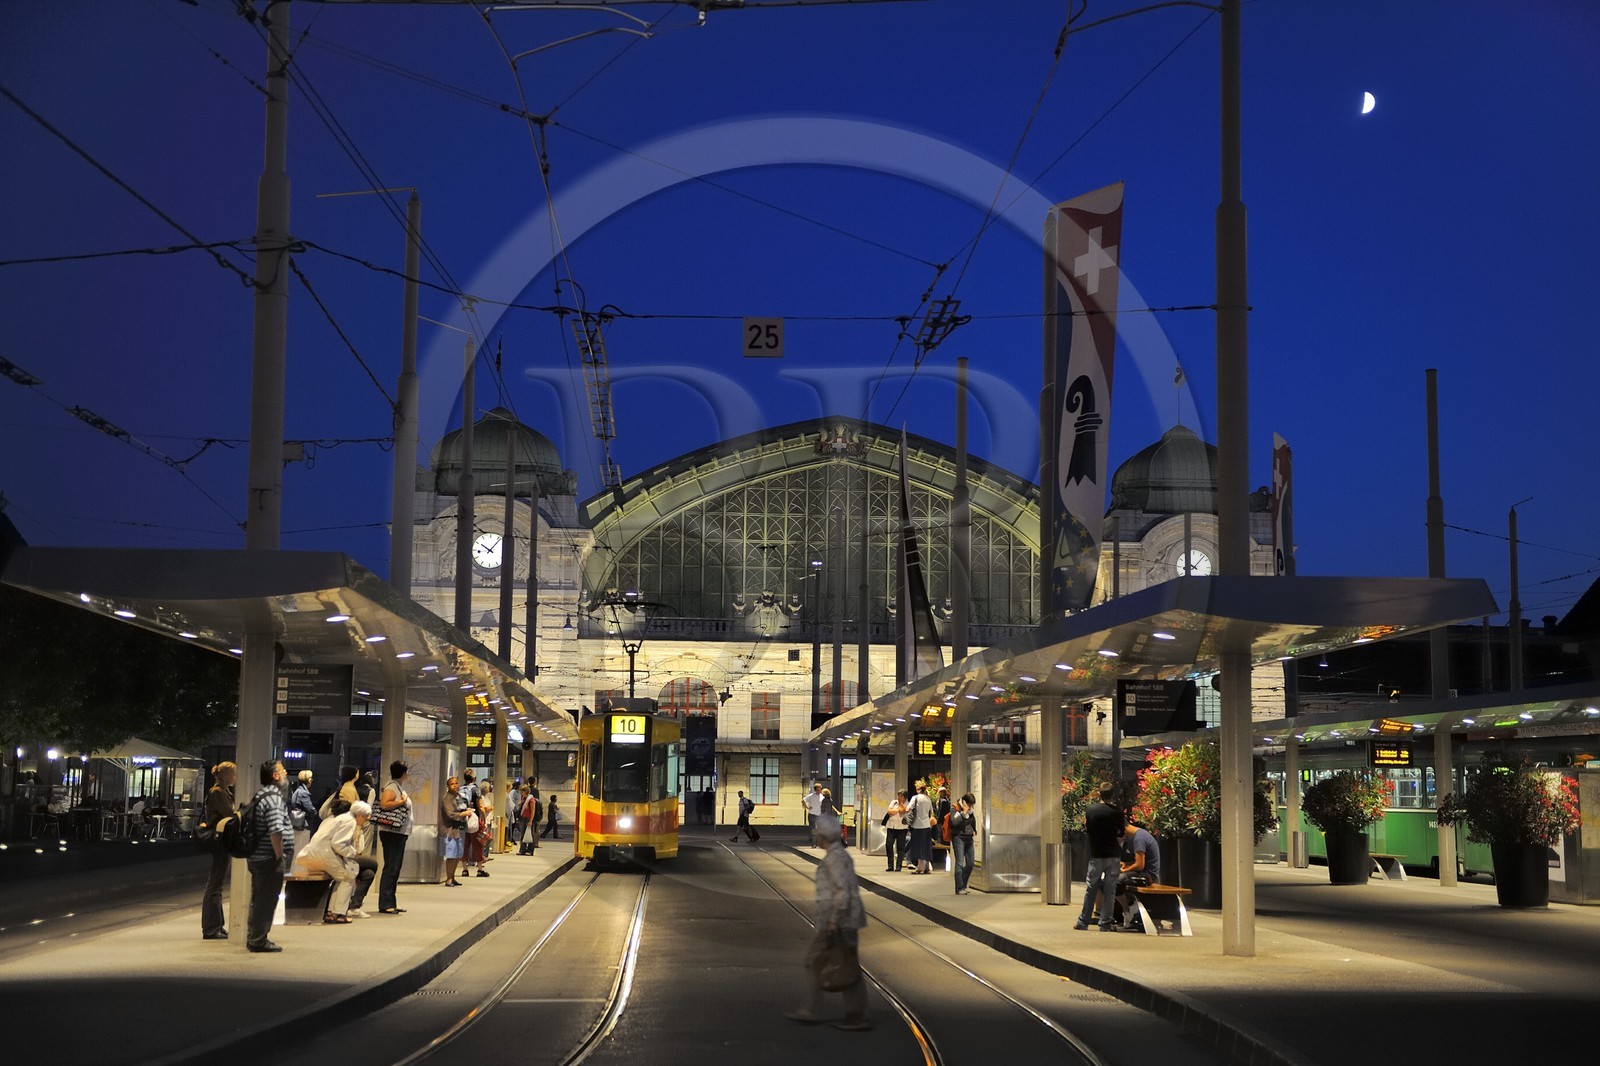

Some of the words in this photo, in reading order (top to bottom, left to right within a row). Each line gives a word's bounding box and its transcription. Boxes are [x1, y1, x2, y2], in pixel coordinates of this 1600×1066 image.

[748, 324, 779, 350] 25
[790, 651, 798, 660] 15
[620, 719, 636, 733] 10
